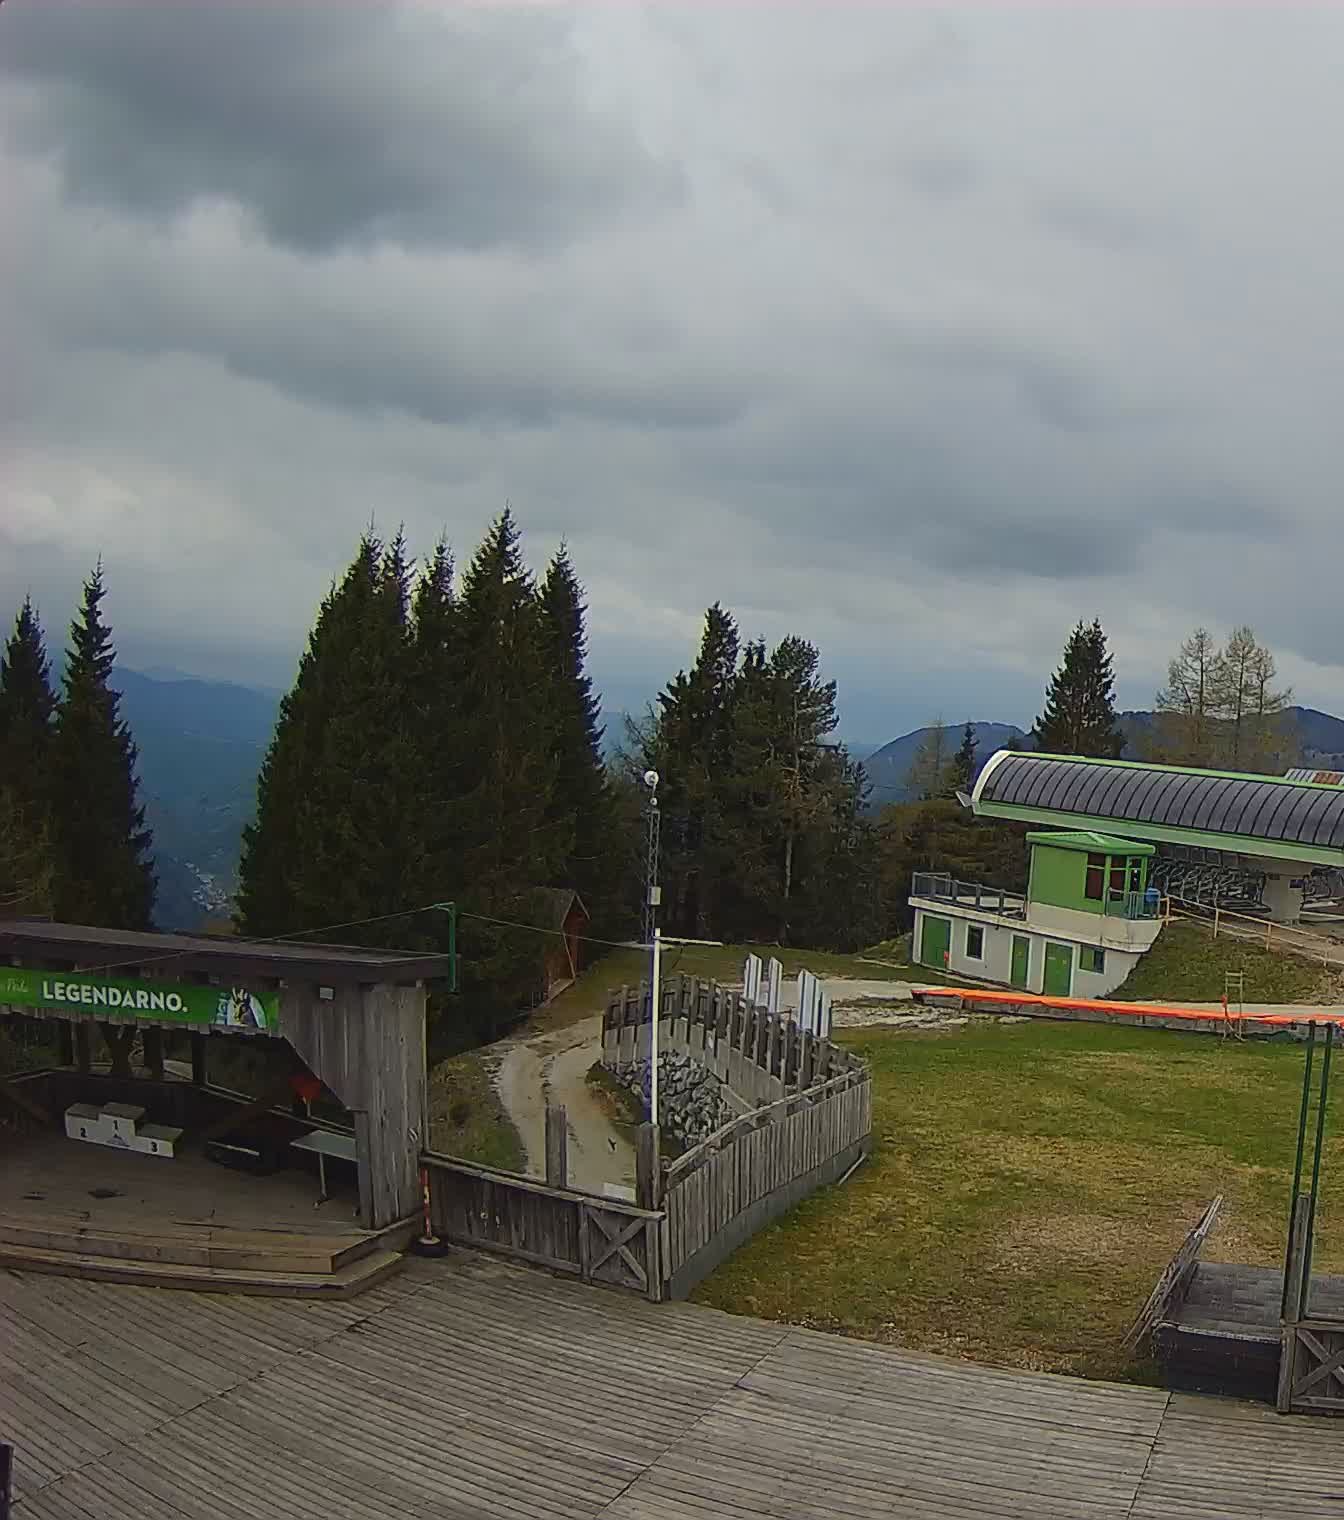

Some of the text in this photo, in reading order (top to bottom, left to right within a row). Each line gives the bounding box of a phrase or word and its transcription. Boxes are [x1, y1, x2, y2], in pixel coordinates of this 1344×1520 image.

[42, 980, 189, 1012] LEGENDARNO.
[113, 1119, 119, 1130] 1
[80, 1127, 87, 1138] 2
[151, 1141, 158, 1153] 3
